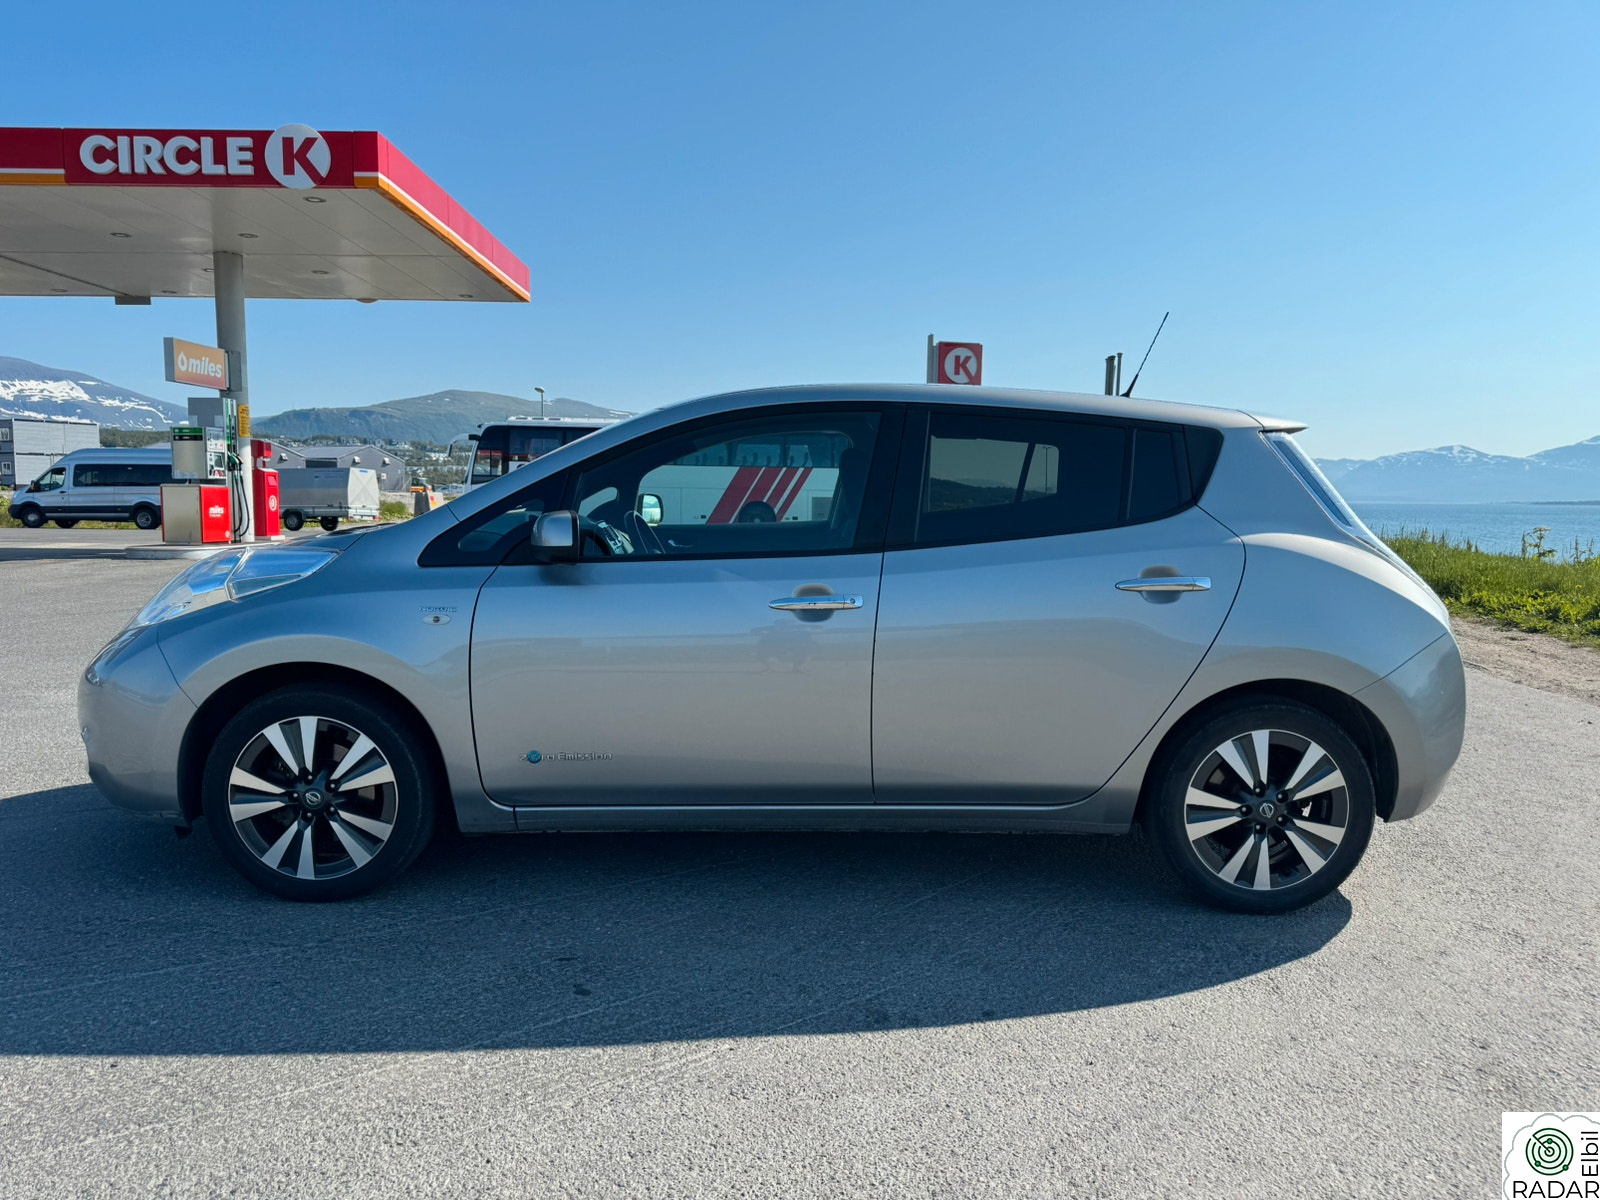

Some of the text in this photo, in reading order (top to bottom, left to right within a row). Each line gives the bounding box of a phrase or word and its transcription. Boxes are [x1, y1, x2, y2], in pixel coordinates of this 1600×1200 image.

[79, 135, 325, 184] CIRCLE K
[188, 356, 223, 378] miles
[954, 355, 973, 380] K
[557, 751, 613, 761] Emission
